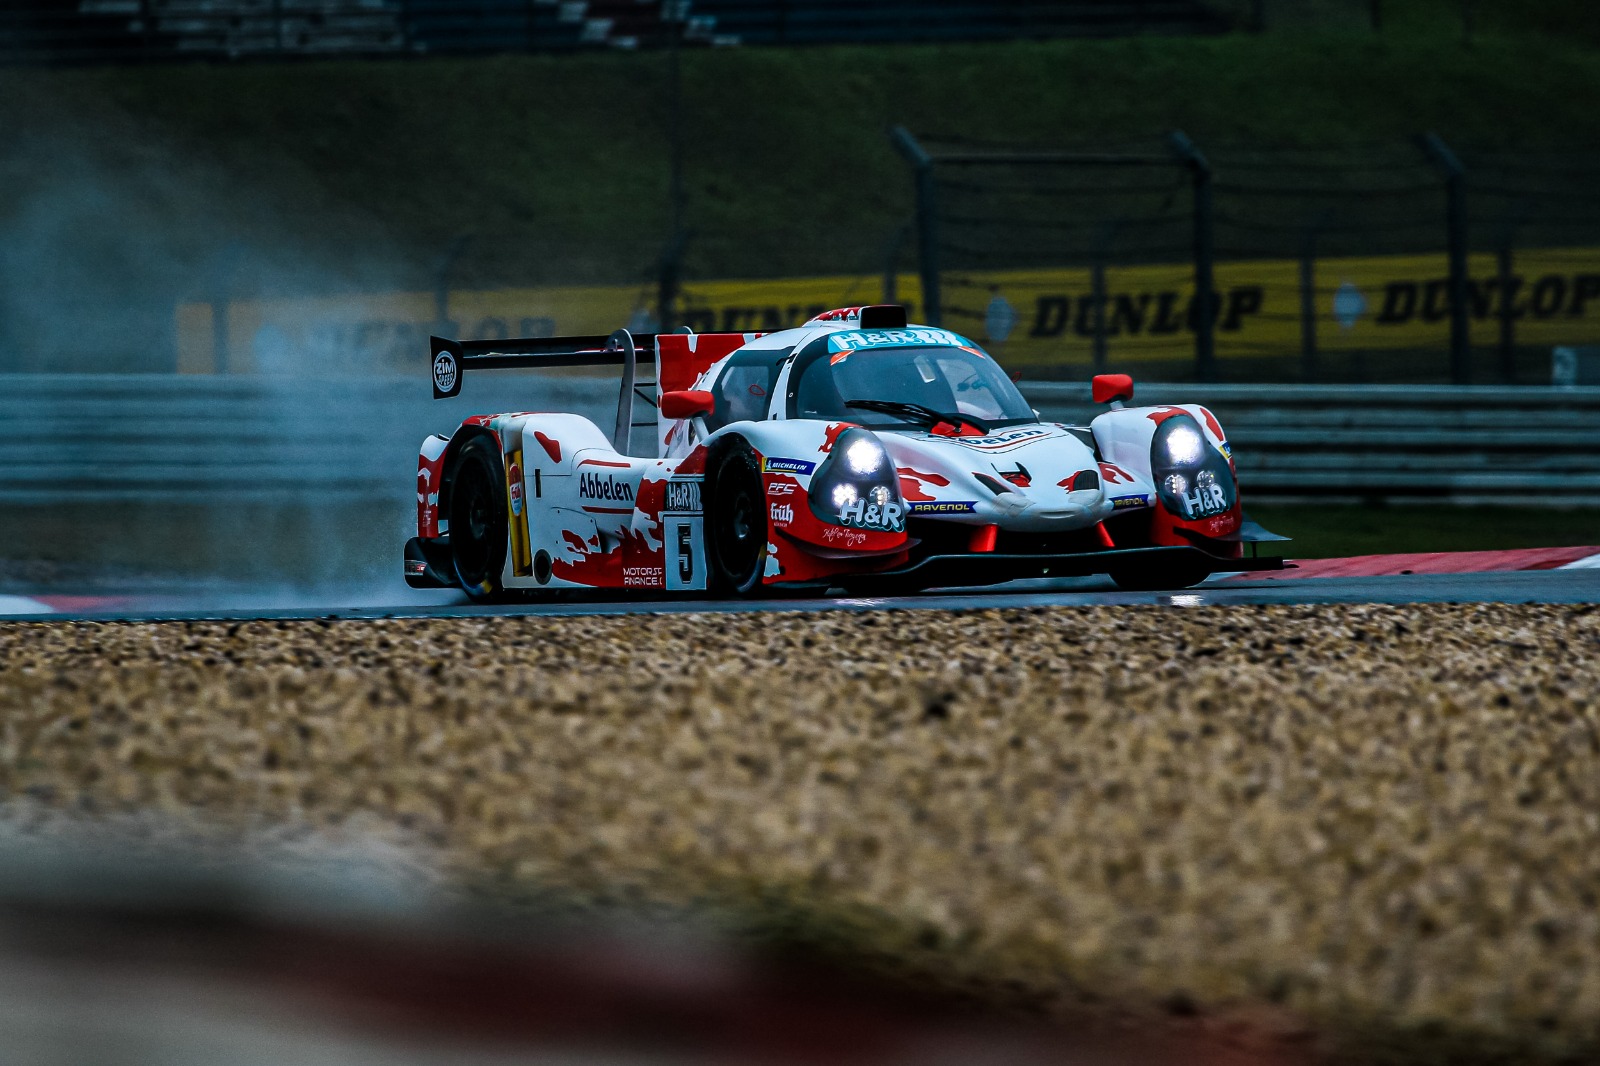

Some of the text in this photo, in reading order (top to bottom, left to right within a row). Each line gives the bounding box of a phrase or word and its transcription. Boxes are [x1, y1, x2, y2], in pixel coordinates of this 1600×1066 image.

[831, 330, 911, 350] H&R
[772, 462, 807, 471] MICHELIN
[579, 472, 634, 501] Abbelen
[768, 482, 798, 492] PFC
[914, 502, 971, 512] RAVENOL
[1182, 484, 1227, 515] H&R
[770, 502, 794, 524] früh
[840, 498, 903, 530] H&R
[676, 522, 694, 584] 5
